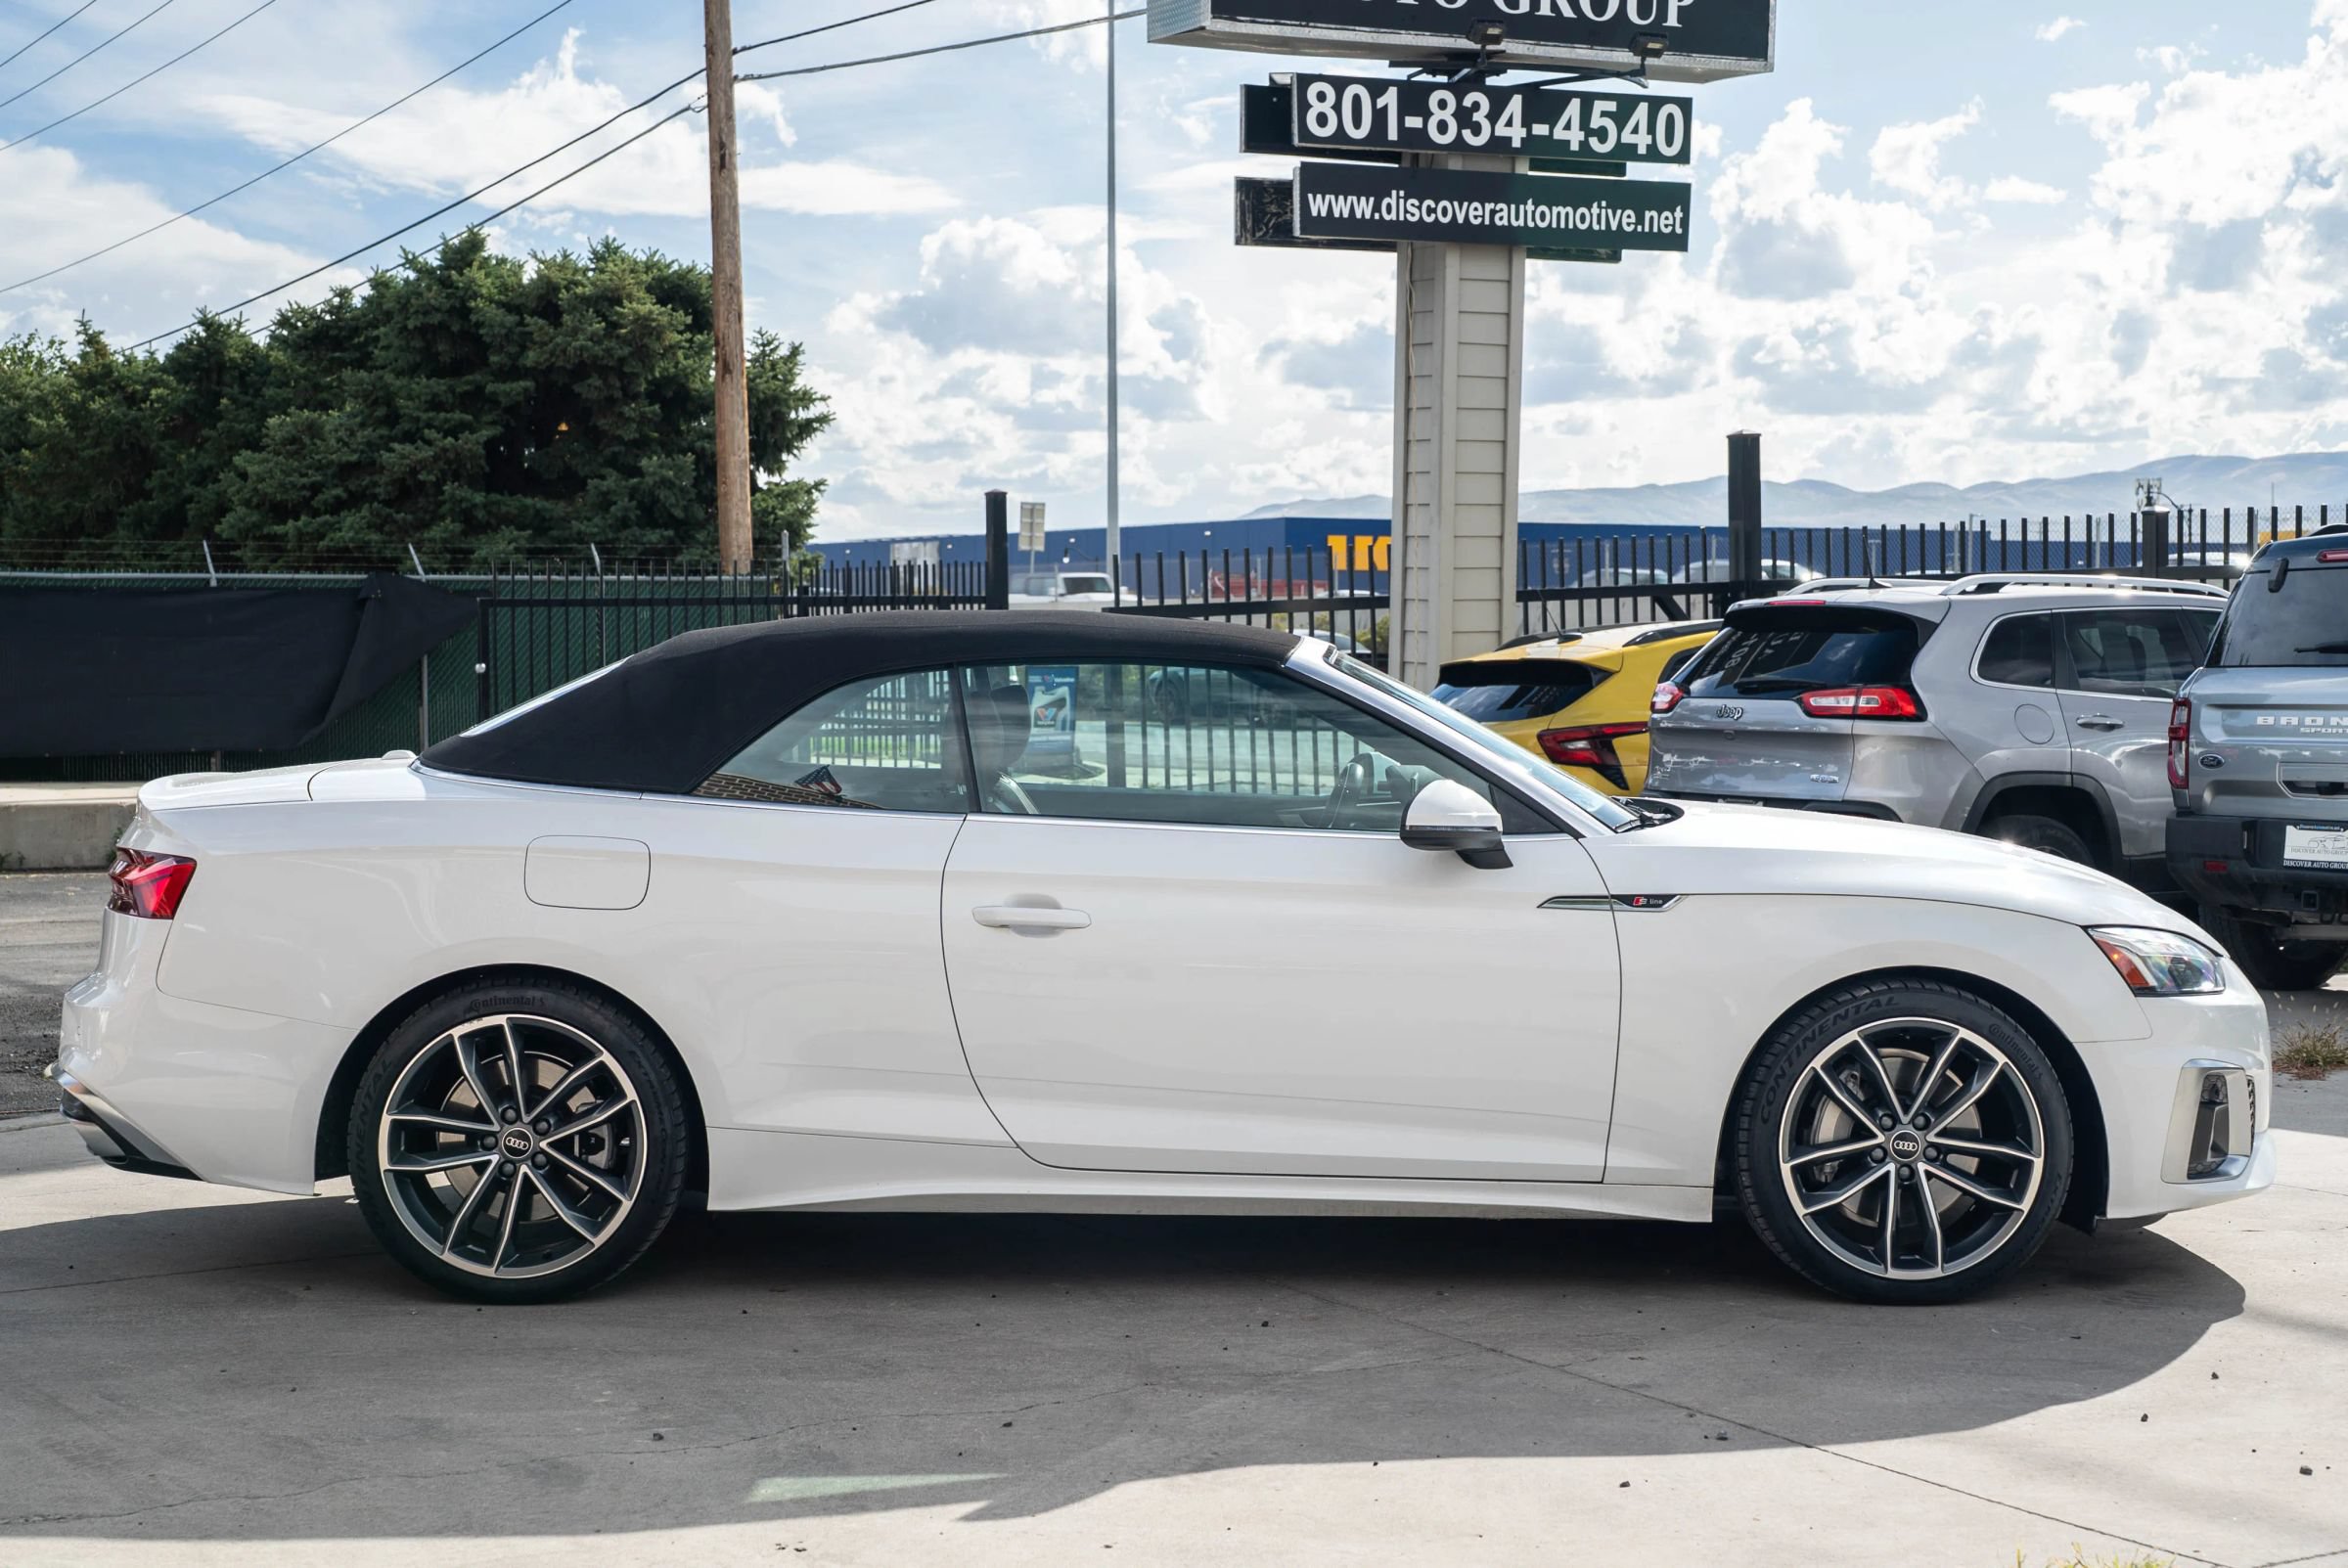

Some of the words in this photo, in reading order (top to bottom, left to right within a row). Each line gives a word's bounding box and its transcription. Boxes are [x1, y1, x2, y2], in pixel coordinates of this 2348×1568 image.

[1305, 82, 1685, 157] 801-834-4540
[1308, 191, 1684, 235] www.discoverautomotive.net
[1716, 703, 1743, 721] Jeep
[2283, 859, 2312, 868] DISCOVER
[470, 995, 535, 1011] Continental
[1761, 996, 1901, 1124] CONTINENTAL
